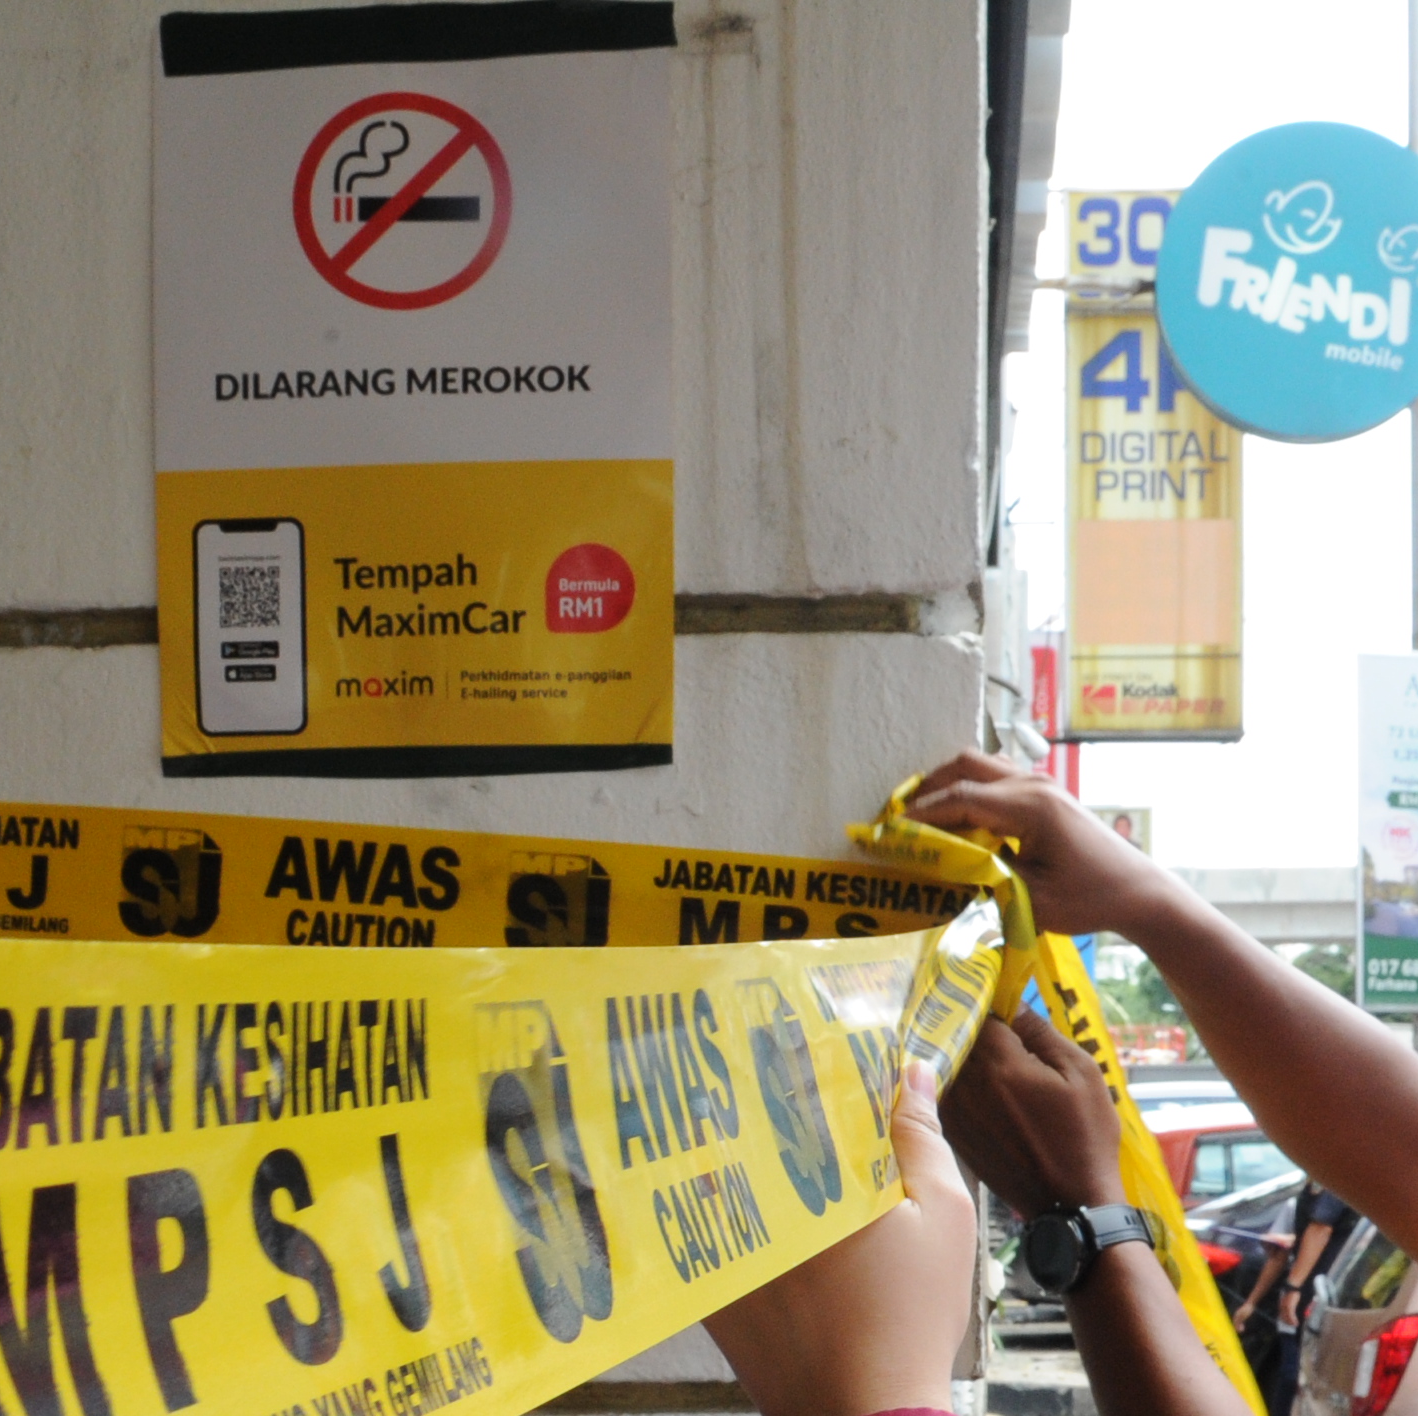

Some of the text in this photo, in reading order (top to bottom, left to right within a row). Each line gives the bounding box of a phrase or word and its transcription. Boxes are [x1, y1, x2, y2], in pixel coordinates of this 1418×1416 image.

[1324, 343, 1404, 372] mobile
[214, 364, 591, 402] DILARANG MEROKOK
[1082, 430, 1229, 464] DIGITAL
[1095, 467, 1215, 502] PRINT
[333, 553, 478, 594] Tempah
[558, 578, 621, 593] Bermula
[335, 601, 527, 638] MaximCar
[558, 596, 605, 619] RM1
[335, 670, 434, 698] maxim
[459, 668, 633, 685] Perkhidmatan e-panggilan
[459, 686, 568, 701] E-hailing service
[1121, 683, 1180, 699] Kodak
[264, 834, 462, 912] AWAS
[653, 857, 796, 900] JABATAN
[285, 907, 436, 948] CAUTION
[1367, 957, 1400, 978] 017
[194, 997, 430, 1130] KESIHATAN
[605, 987, 740, 1170] AWAS
[652, 1160, 772, 1285] CAUTION
